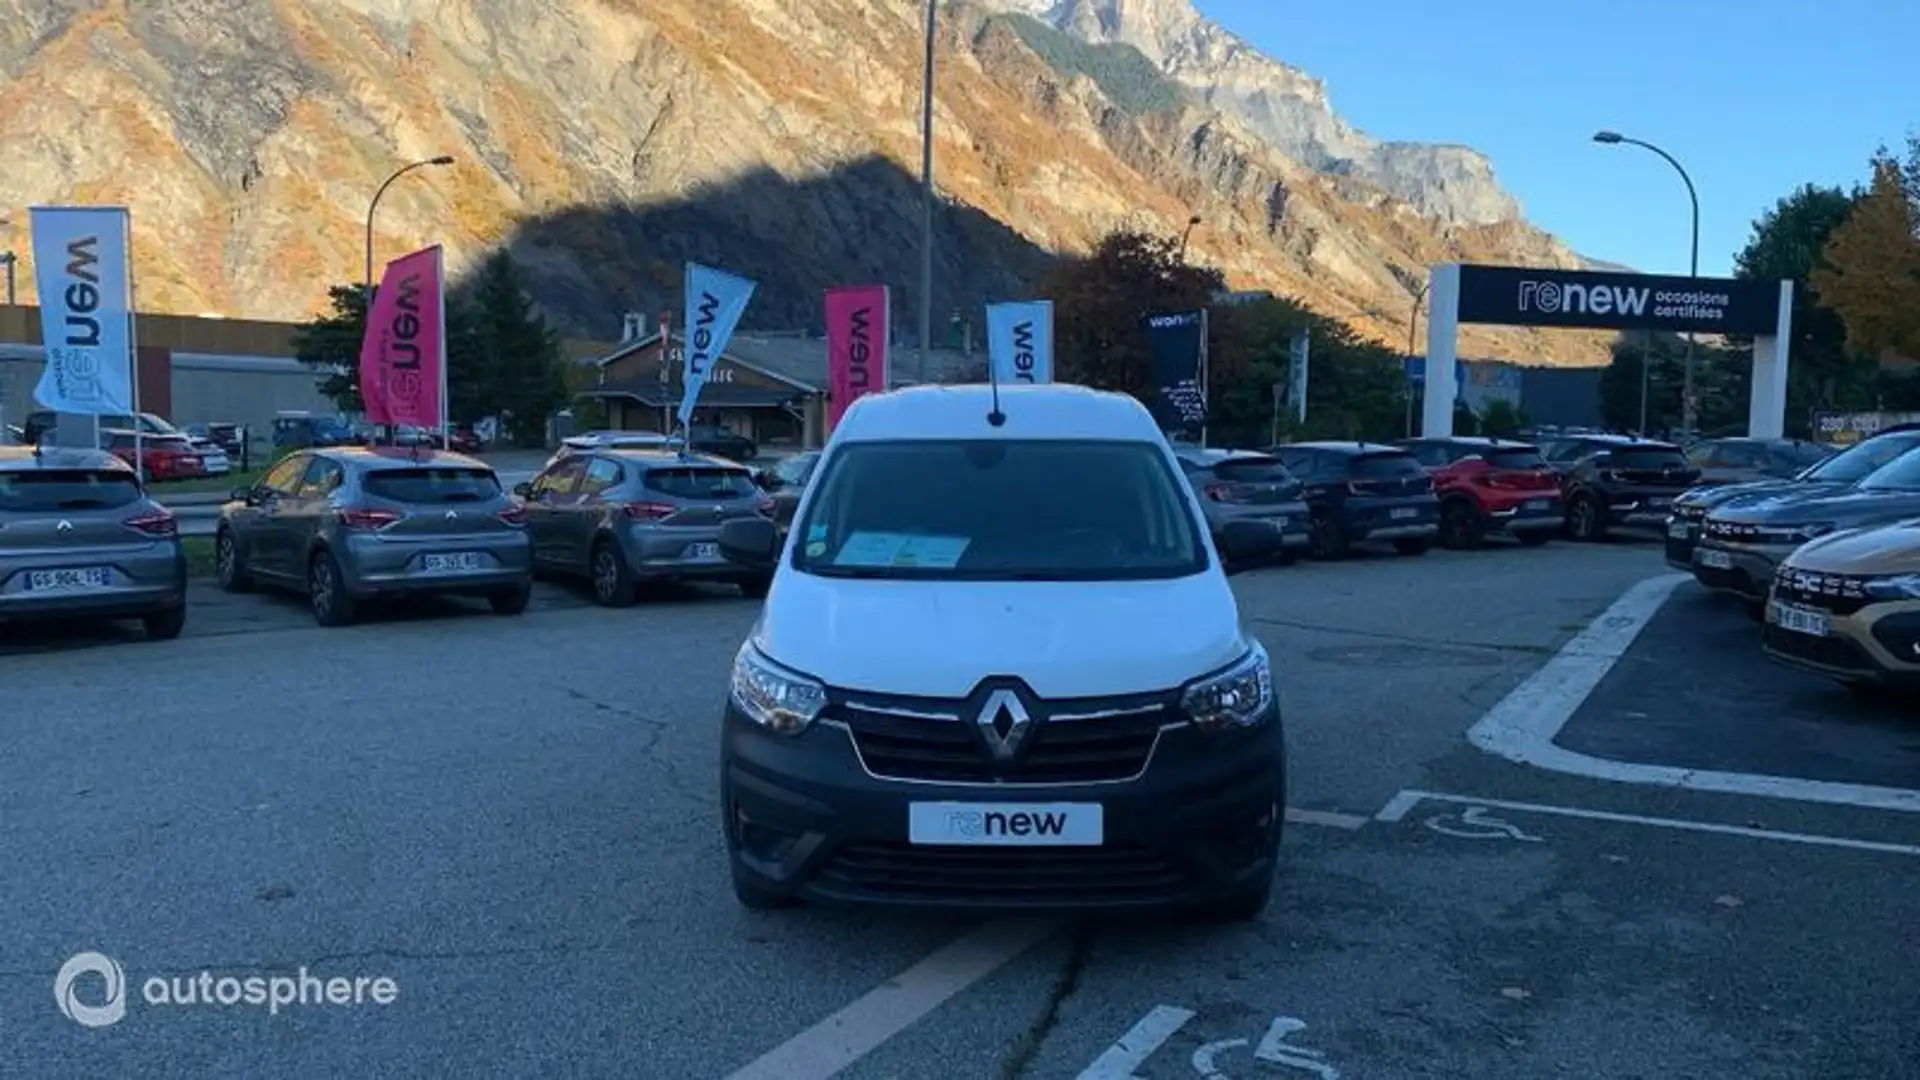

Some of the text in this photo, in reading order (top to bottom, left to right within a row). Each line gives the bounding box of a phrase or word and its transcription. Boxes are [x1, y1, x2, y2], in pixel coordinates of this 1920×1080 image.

[1518, 280, 1650, 316] renew
[1654, 304, 1724, 319] certifiées
[1655, 290, 1728, 306] occasions
[690, 291, 719, 374] new
[943, 811, 1067, 840] renew
